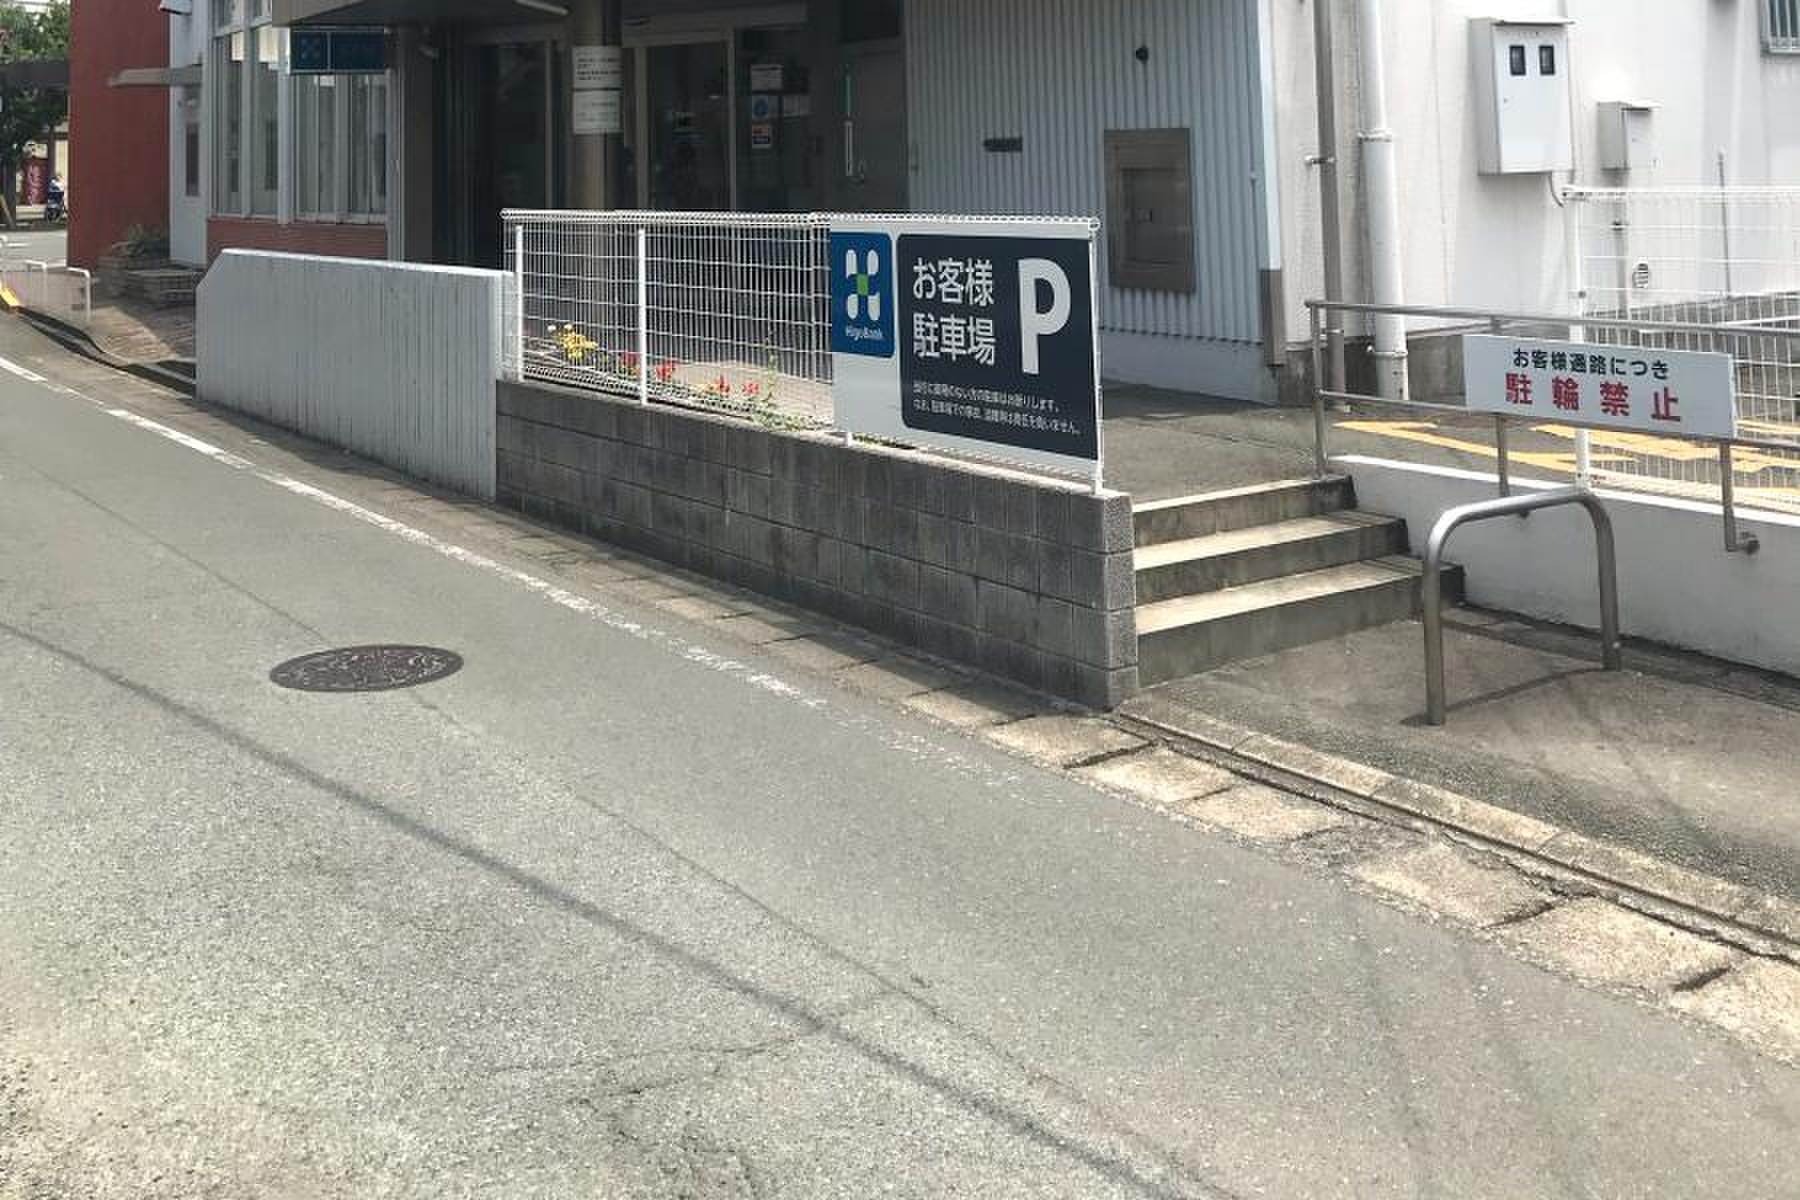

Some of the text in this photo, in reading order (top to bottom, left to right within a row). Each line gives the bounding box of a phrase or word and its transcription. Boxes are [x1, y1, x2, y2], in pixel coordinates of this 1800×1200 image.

[912, 257, 995, 307] お客様
[912, 312, 996, 366] 駐車場
[1017, 258, 1071, 375] P
[1513, 348, 1669, 380] お客様通路につき
[1505, 373, 1681, 422] 駐輪禁止
